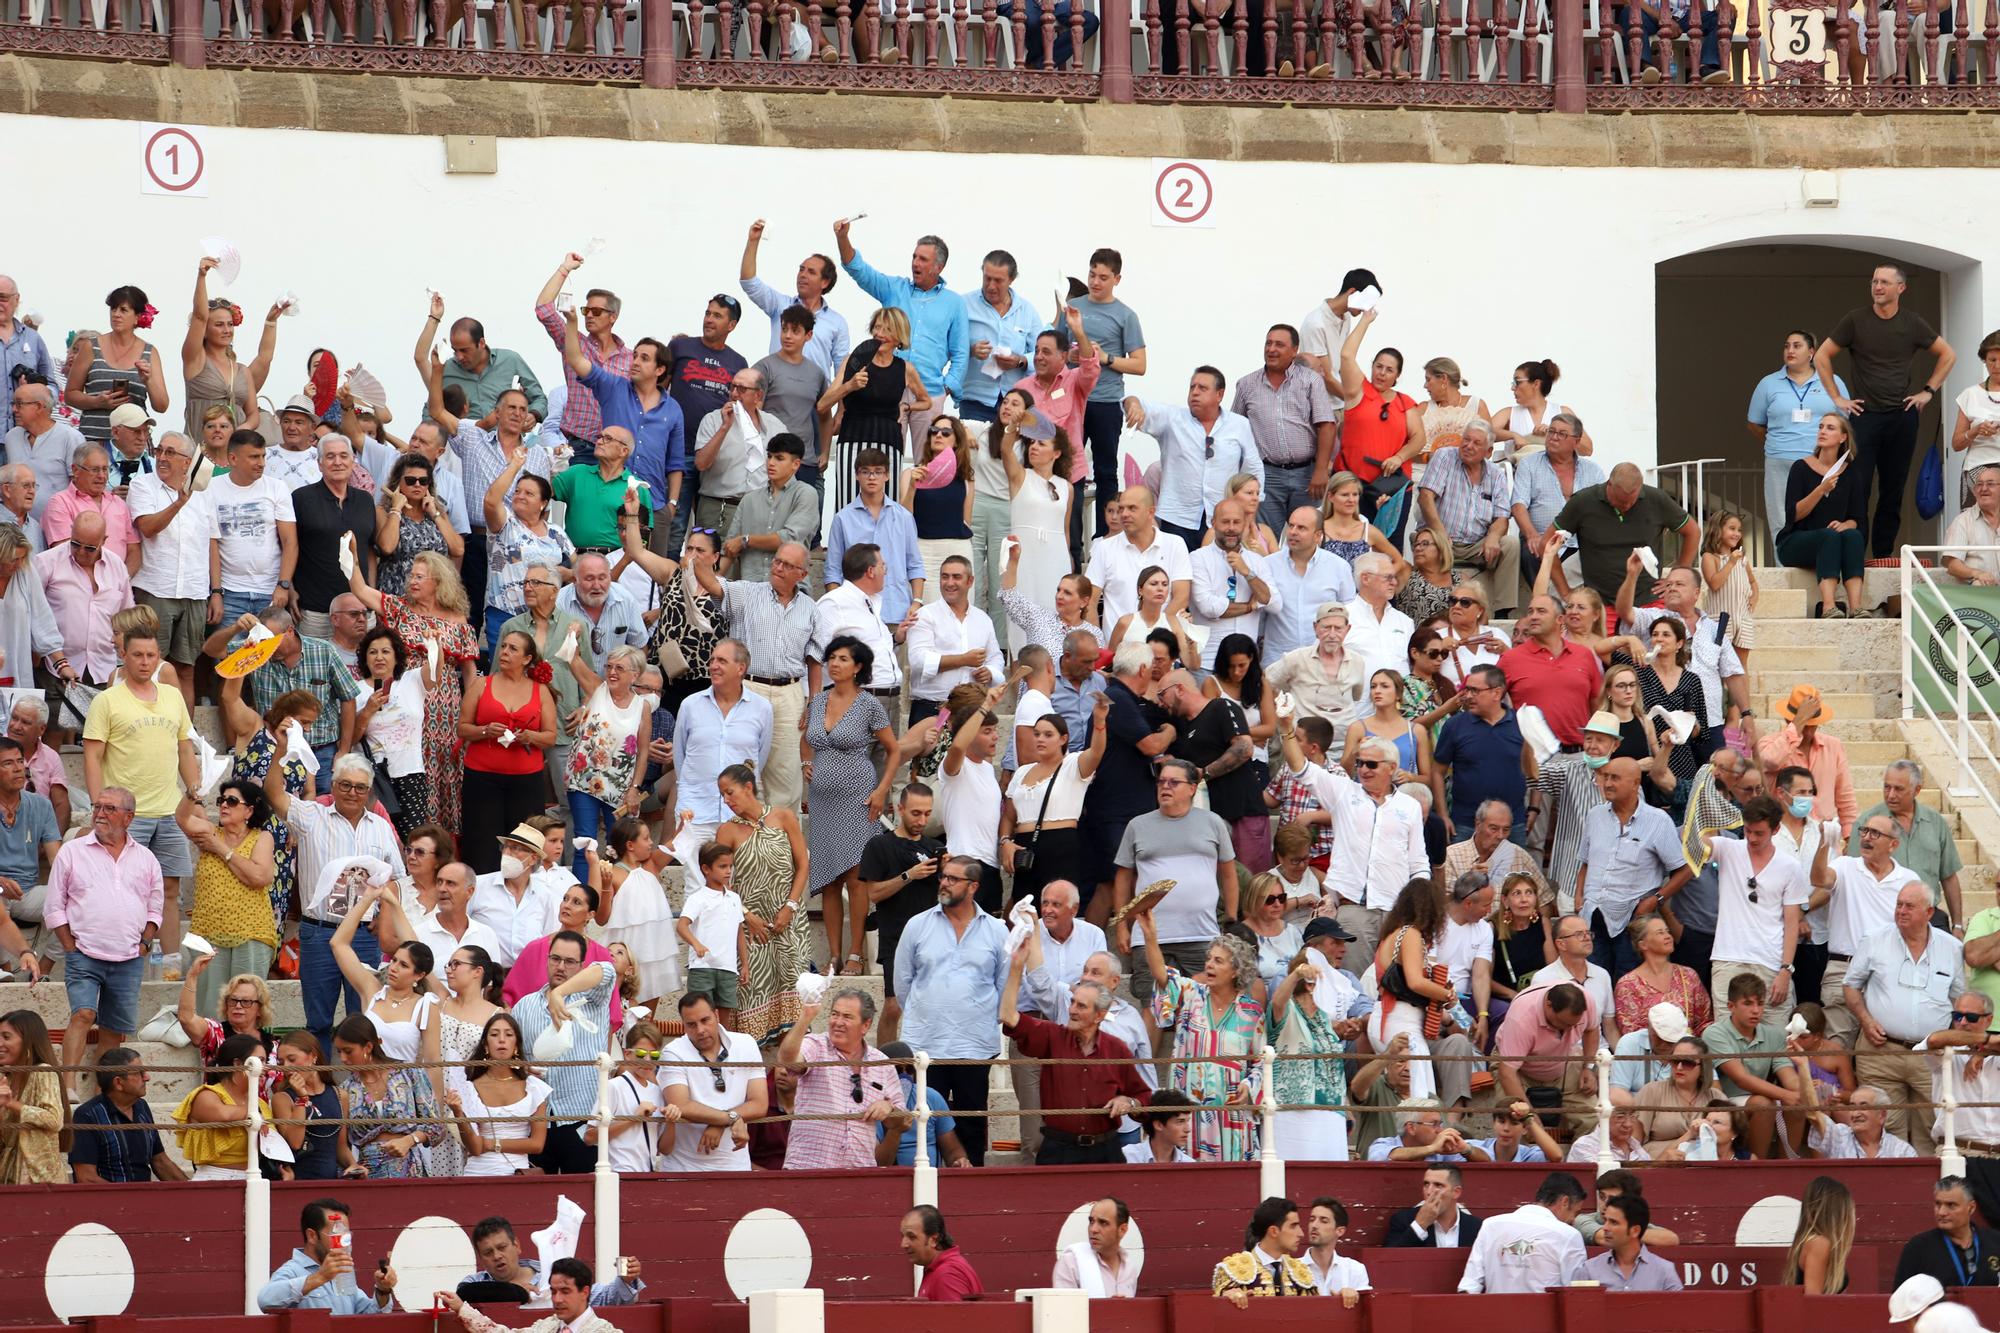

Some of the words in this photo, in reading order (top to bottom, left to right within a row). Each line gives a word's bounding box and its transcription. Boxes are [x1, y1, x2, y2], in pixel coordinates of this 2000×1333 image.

[1789, 15, 1811, 55] 3
[165, 144, 179, 175] 1
[1174, 178, 1194, 208] 2
[1682, 1262, 1758, 1286] DOS
